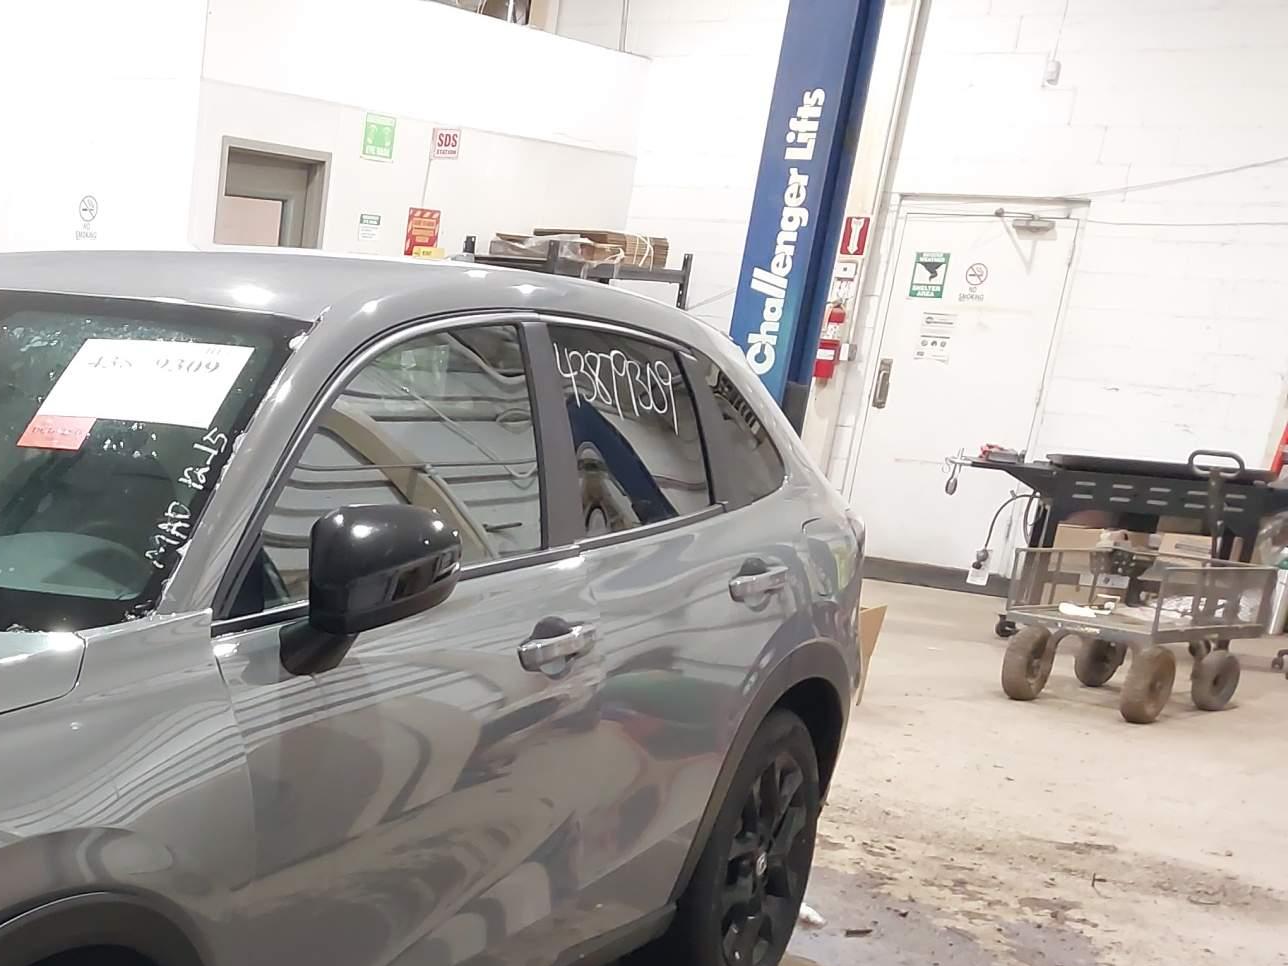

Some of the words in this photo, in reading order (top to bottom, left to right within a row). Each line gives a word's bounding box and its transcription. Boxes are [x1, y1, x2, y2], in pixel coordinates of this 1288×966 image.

[437, 132, 459, 148] SDS
[746, 167, 809, 375] Challenger
[784, 87, 826, 161] Lifts
[553, 342, 679, 436] 43879309
